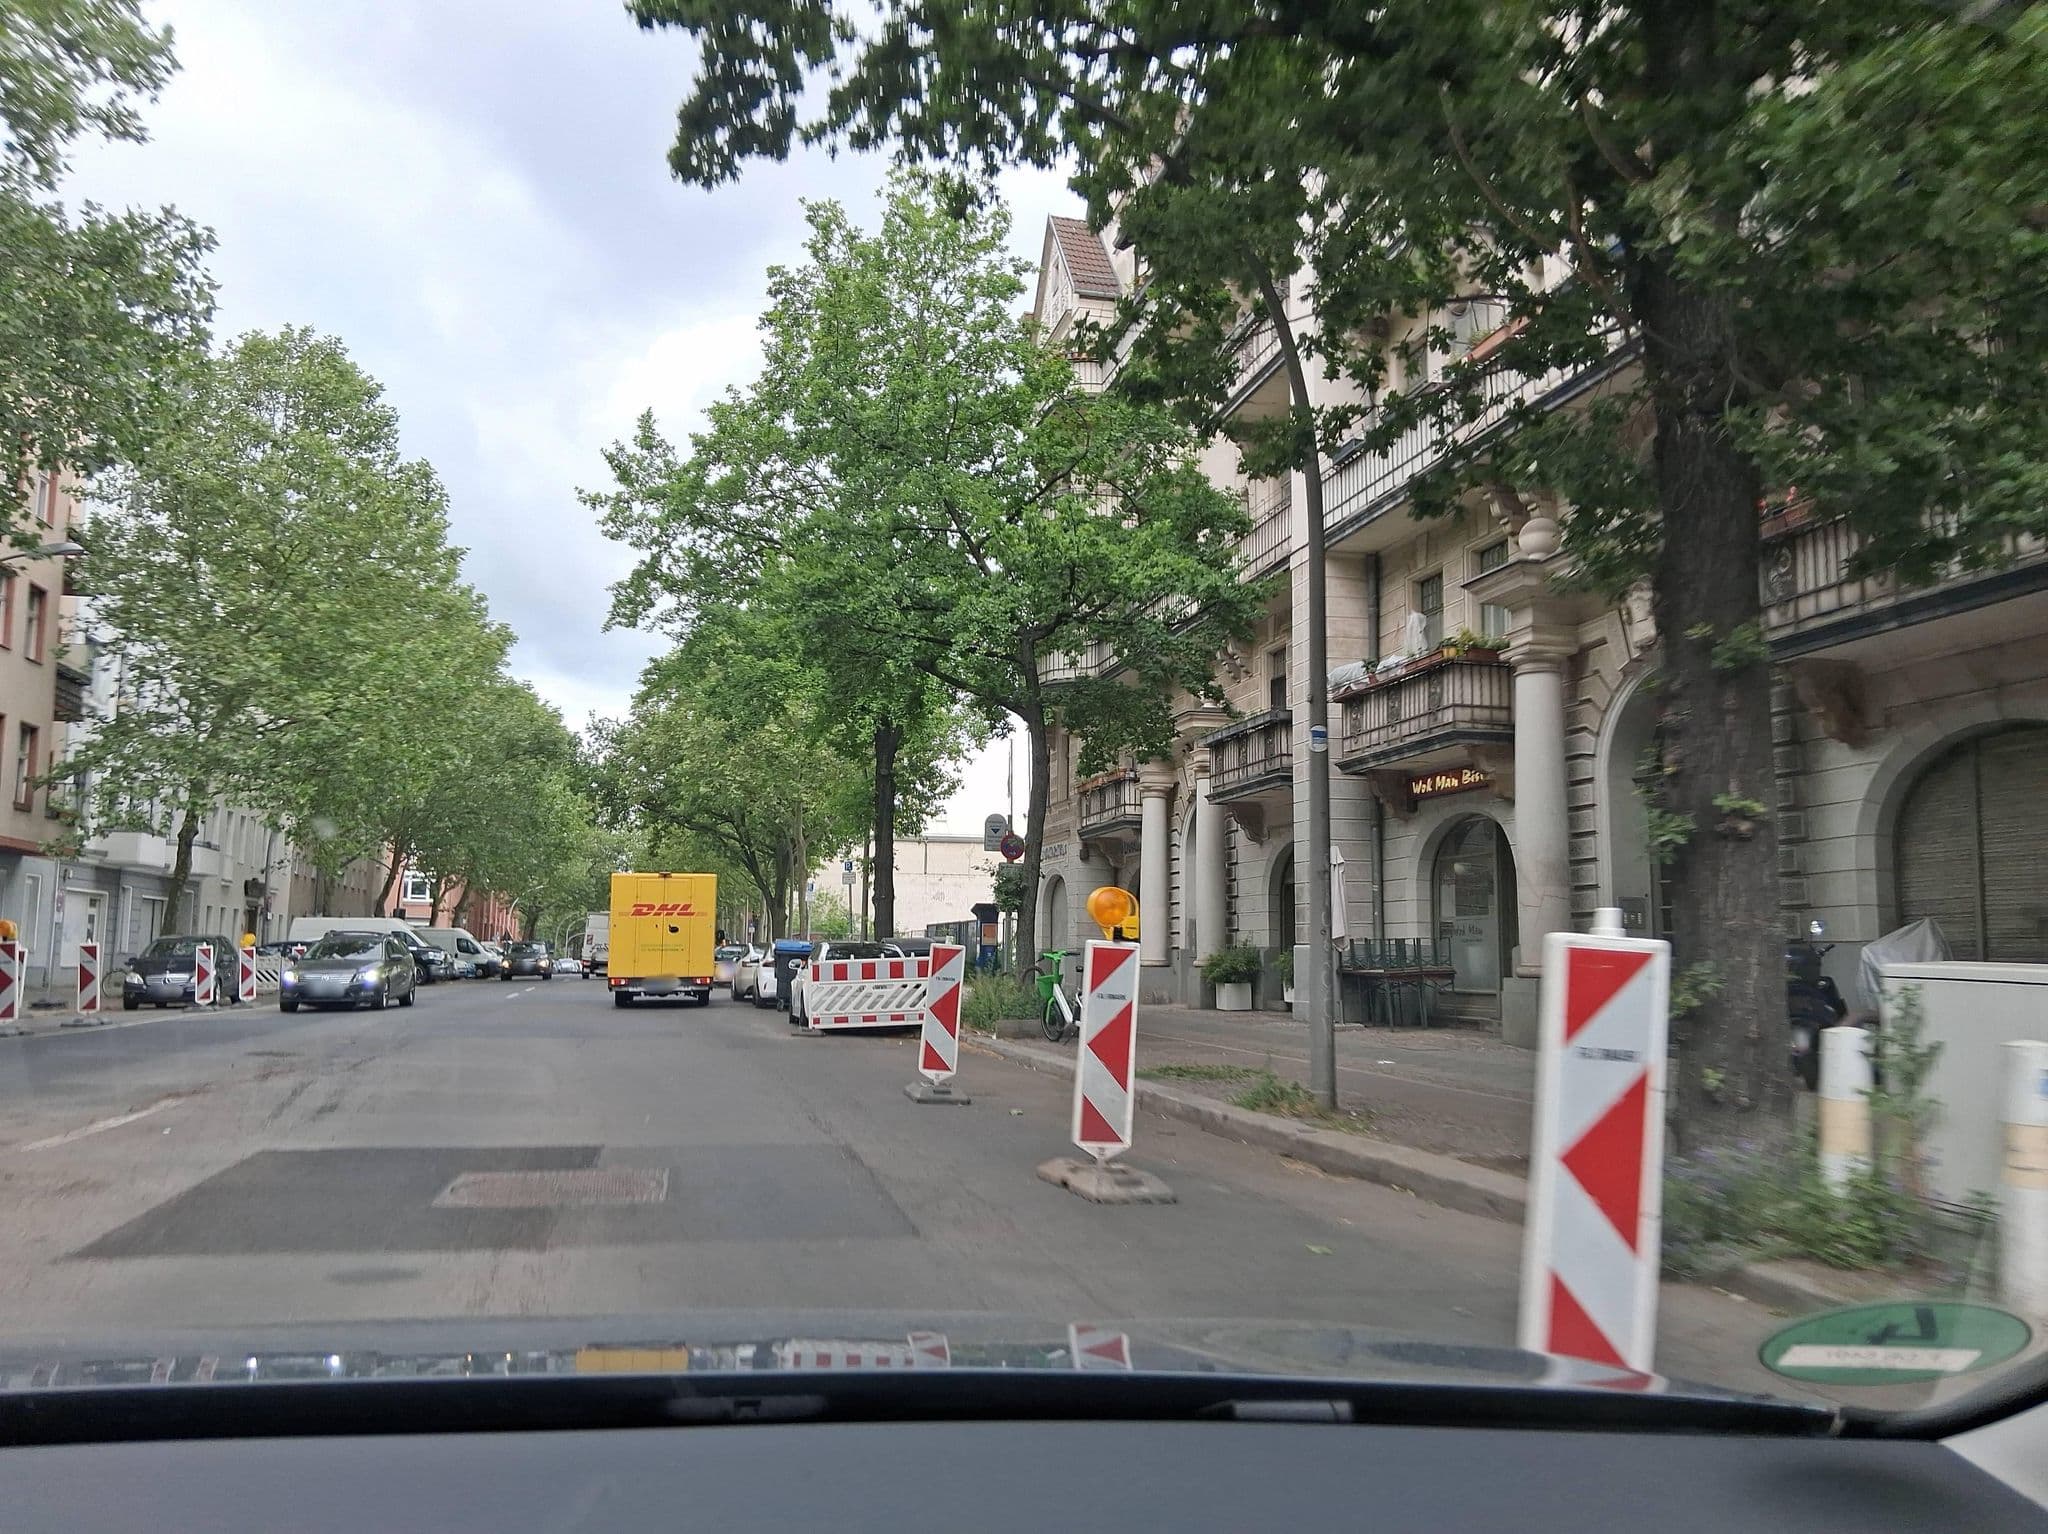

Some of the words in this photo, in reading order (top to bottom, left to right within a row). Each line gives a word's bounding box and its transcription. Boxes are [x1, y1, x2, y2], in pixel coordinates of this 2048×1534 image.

[1412, 777, 1433, 795] Wok
[1435, 775, 1459, 792] Man
[631, 903, 696, 917] DHL
